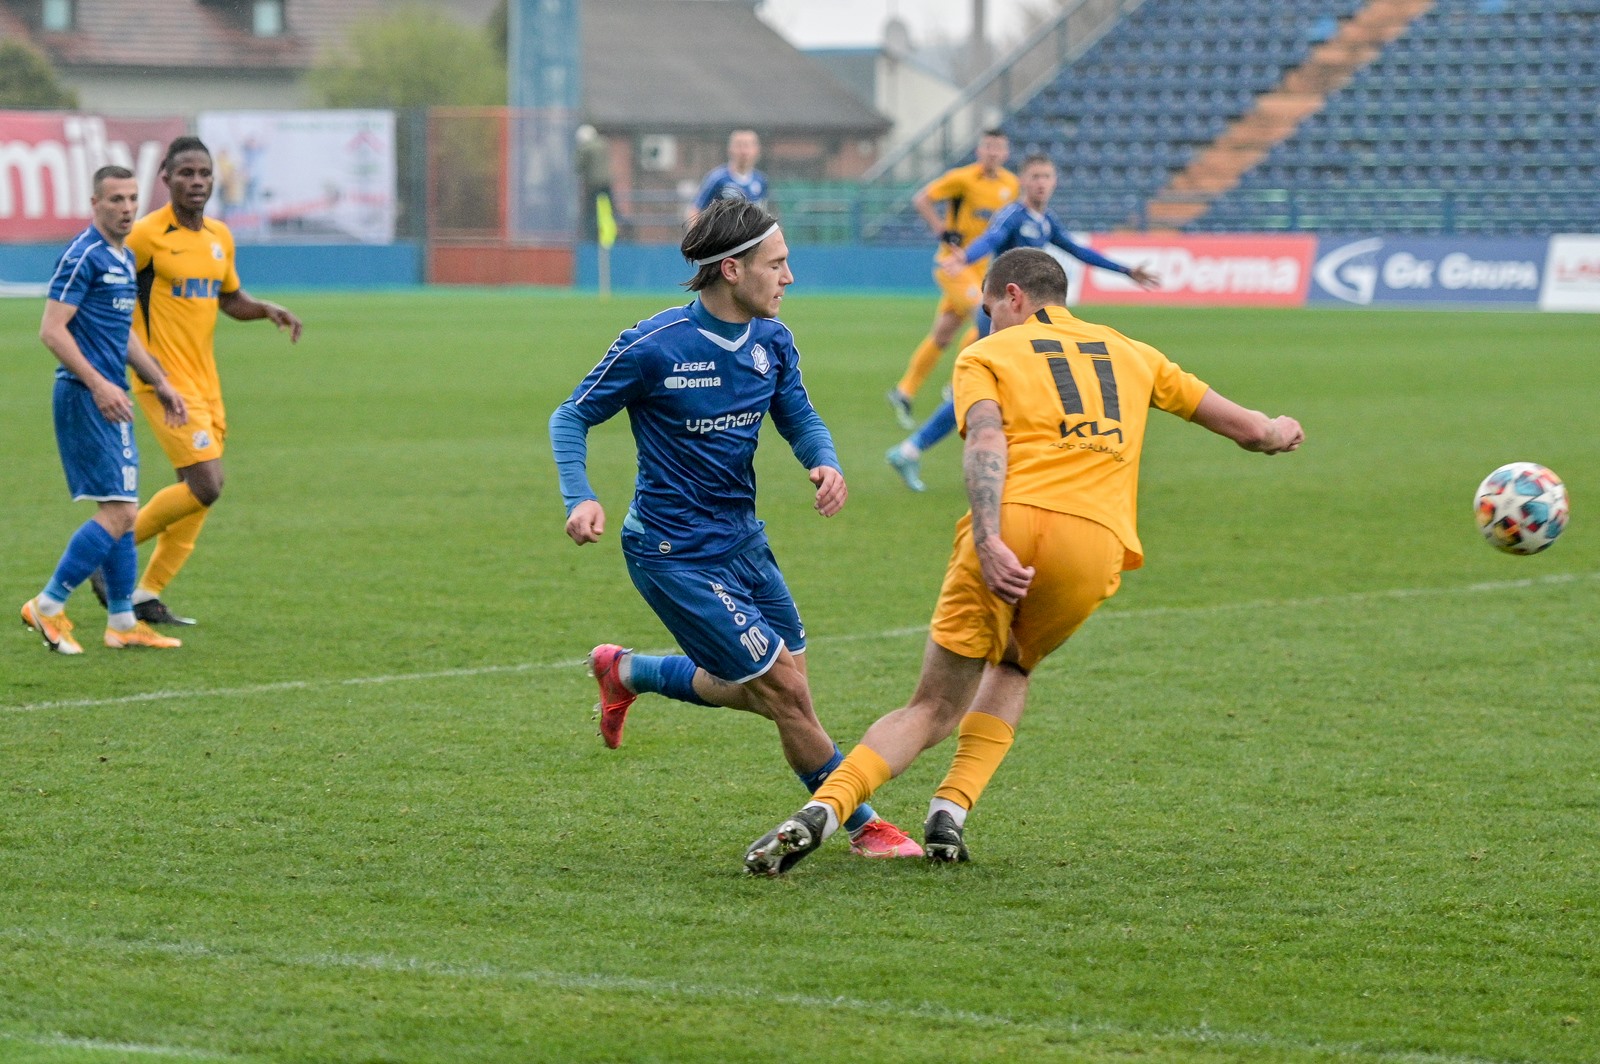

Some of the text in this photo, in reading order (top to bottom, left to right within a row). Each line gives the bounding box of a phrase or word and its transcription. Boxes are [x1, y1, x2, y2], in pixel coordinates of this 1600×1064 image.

[1156, 247, 1299, 295] Derma
[673, 361, 716, 373] LEGEA
[1029, 338, 1122, 424] 11
[677, 376, 722, 389] Derma
[685, 411, 762, 435] upchain
[739, 626, 769, 663] 10
